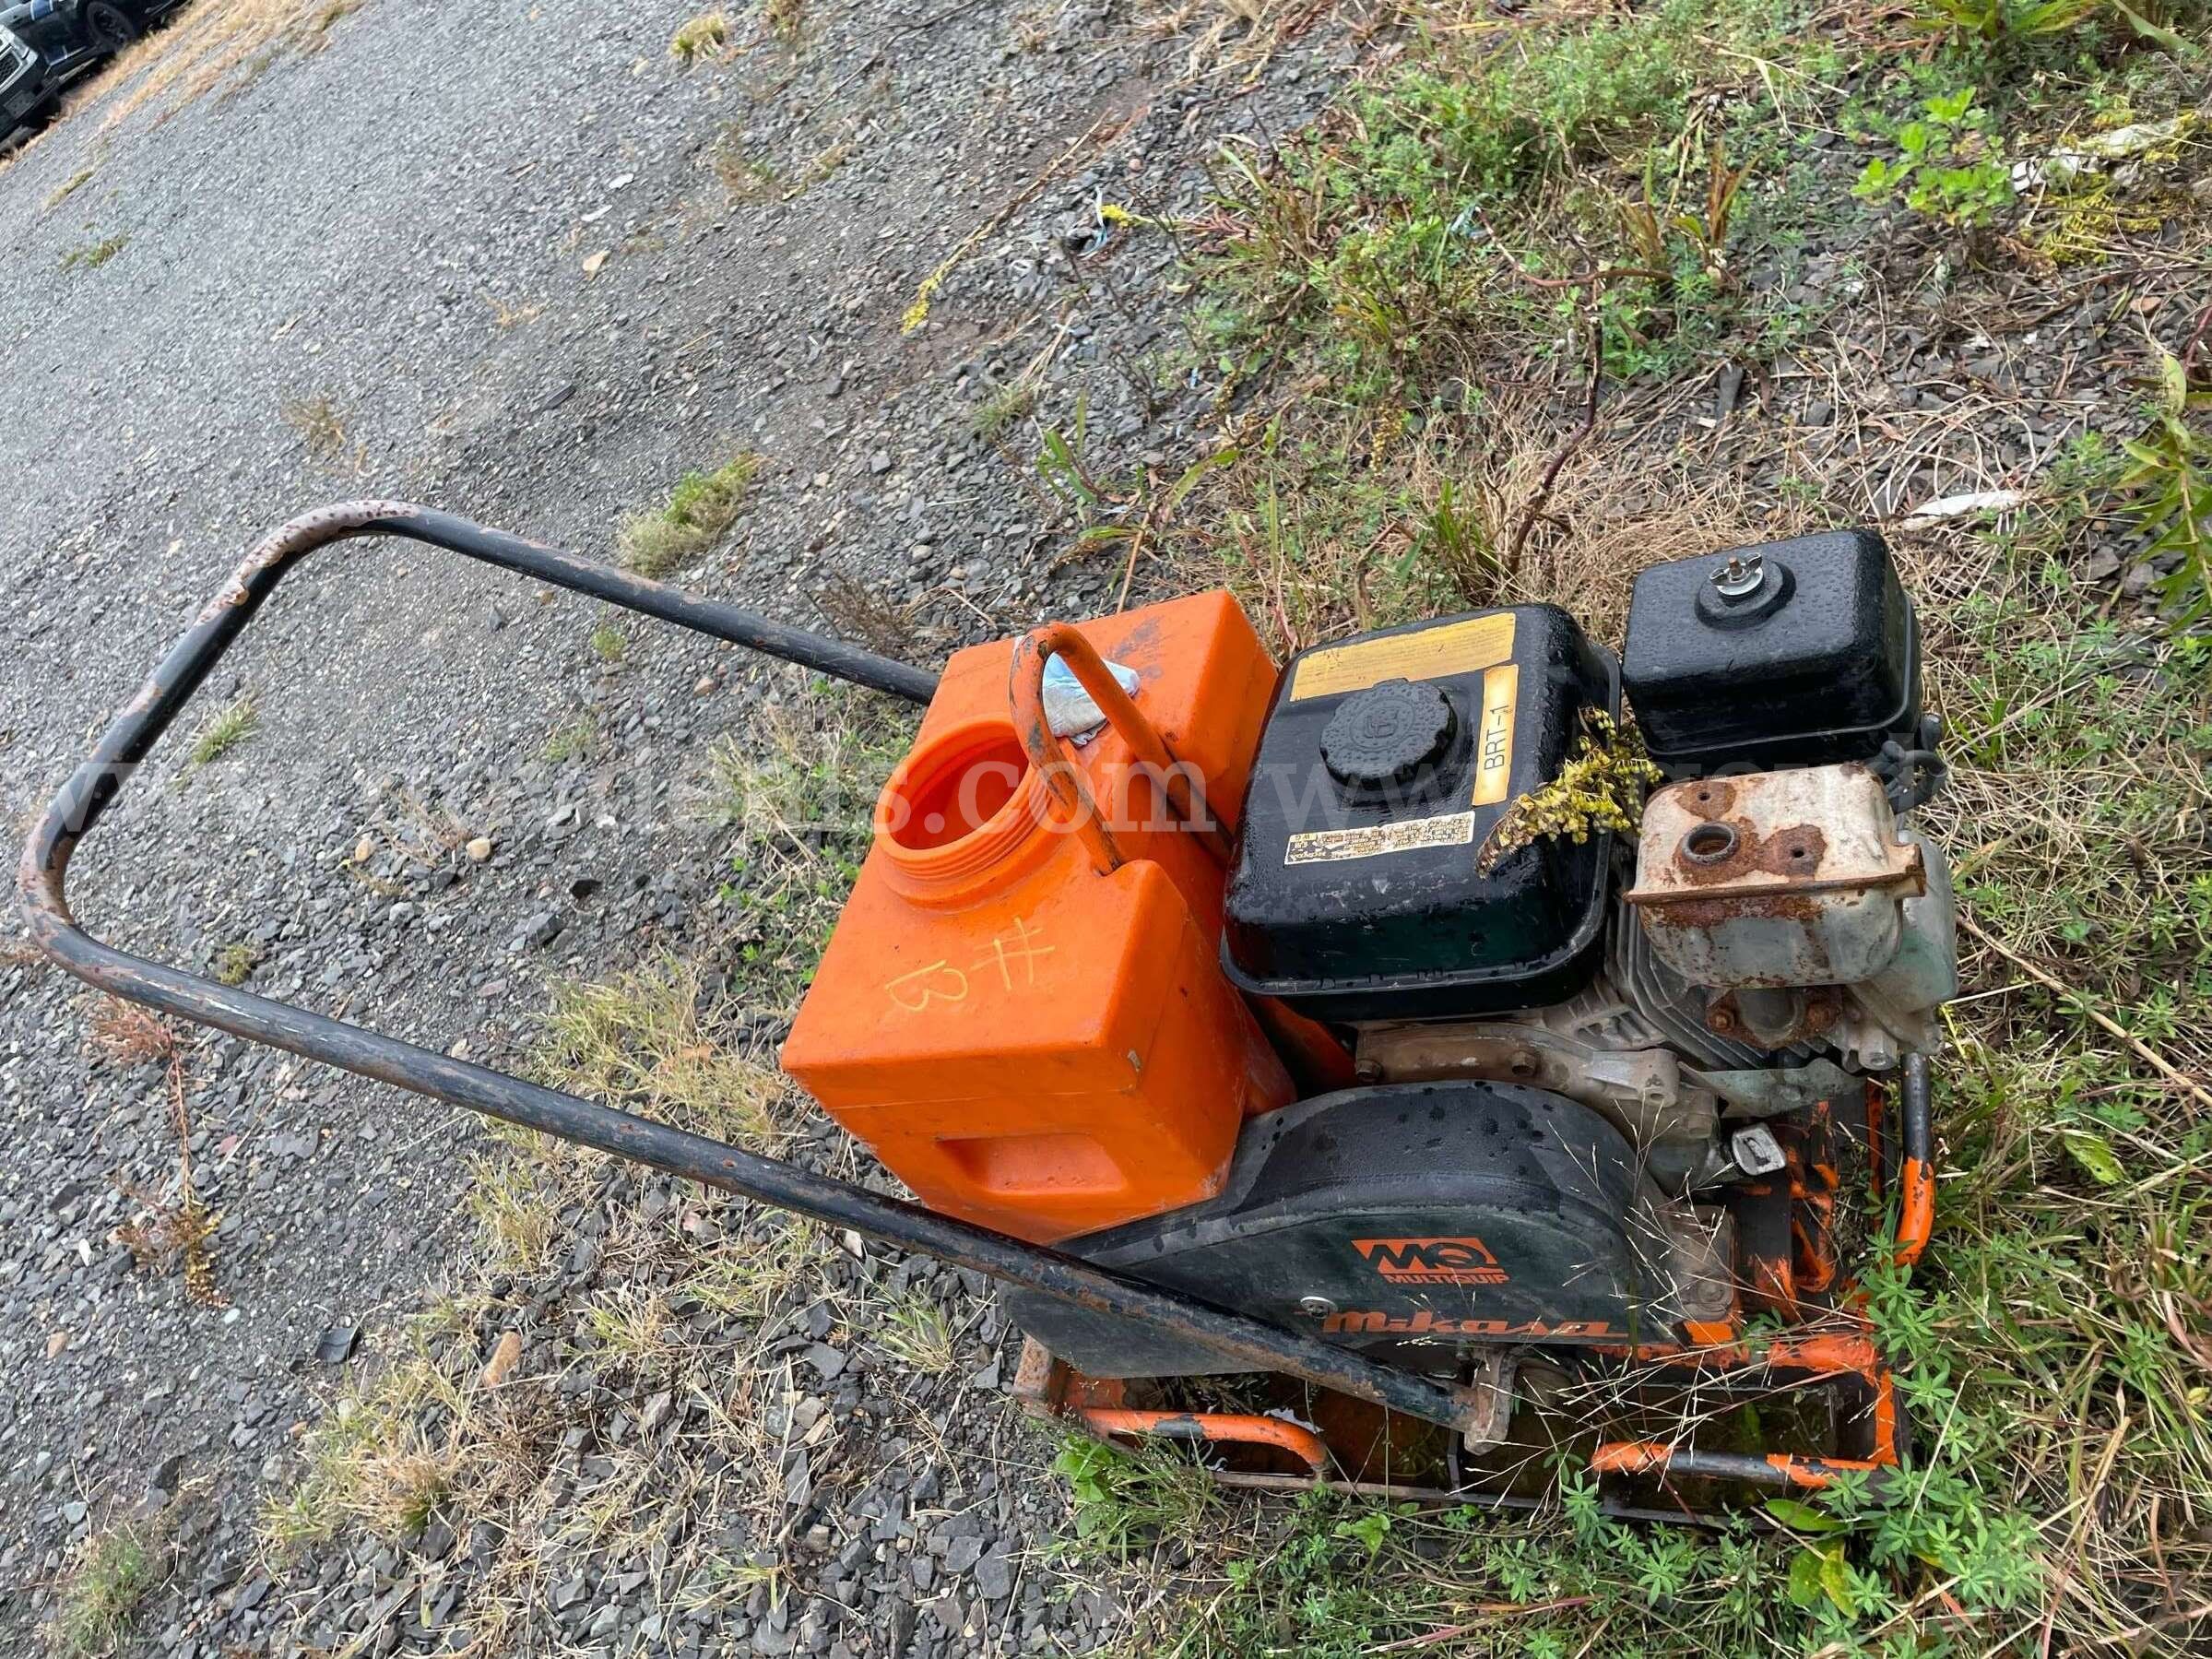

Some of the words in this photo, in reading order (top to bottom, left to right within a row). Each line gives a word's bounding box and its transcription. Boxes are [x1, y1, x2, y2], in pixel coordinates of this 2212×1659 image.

[1484, 705, 1510, 771] BRT-1
[1364, 1240, 1505, 1273] MQ
[1383, 1274, 1510, 1285] MULTIQUIP
